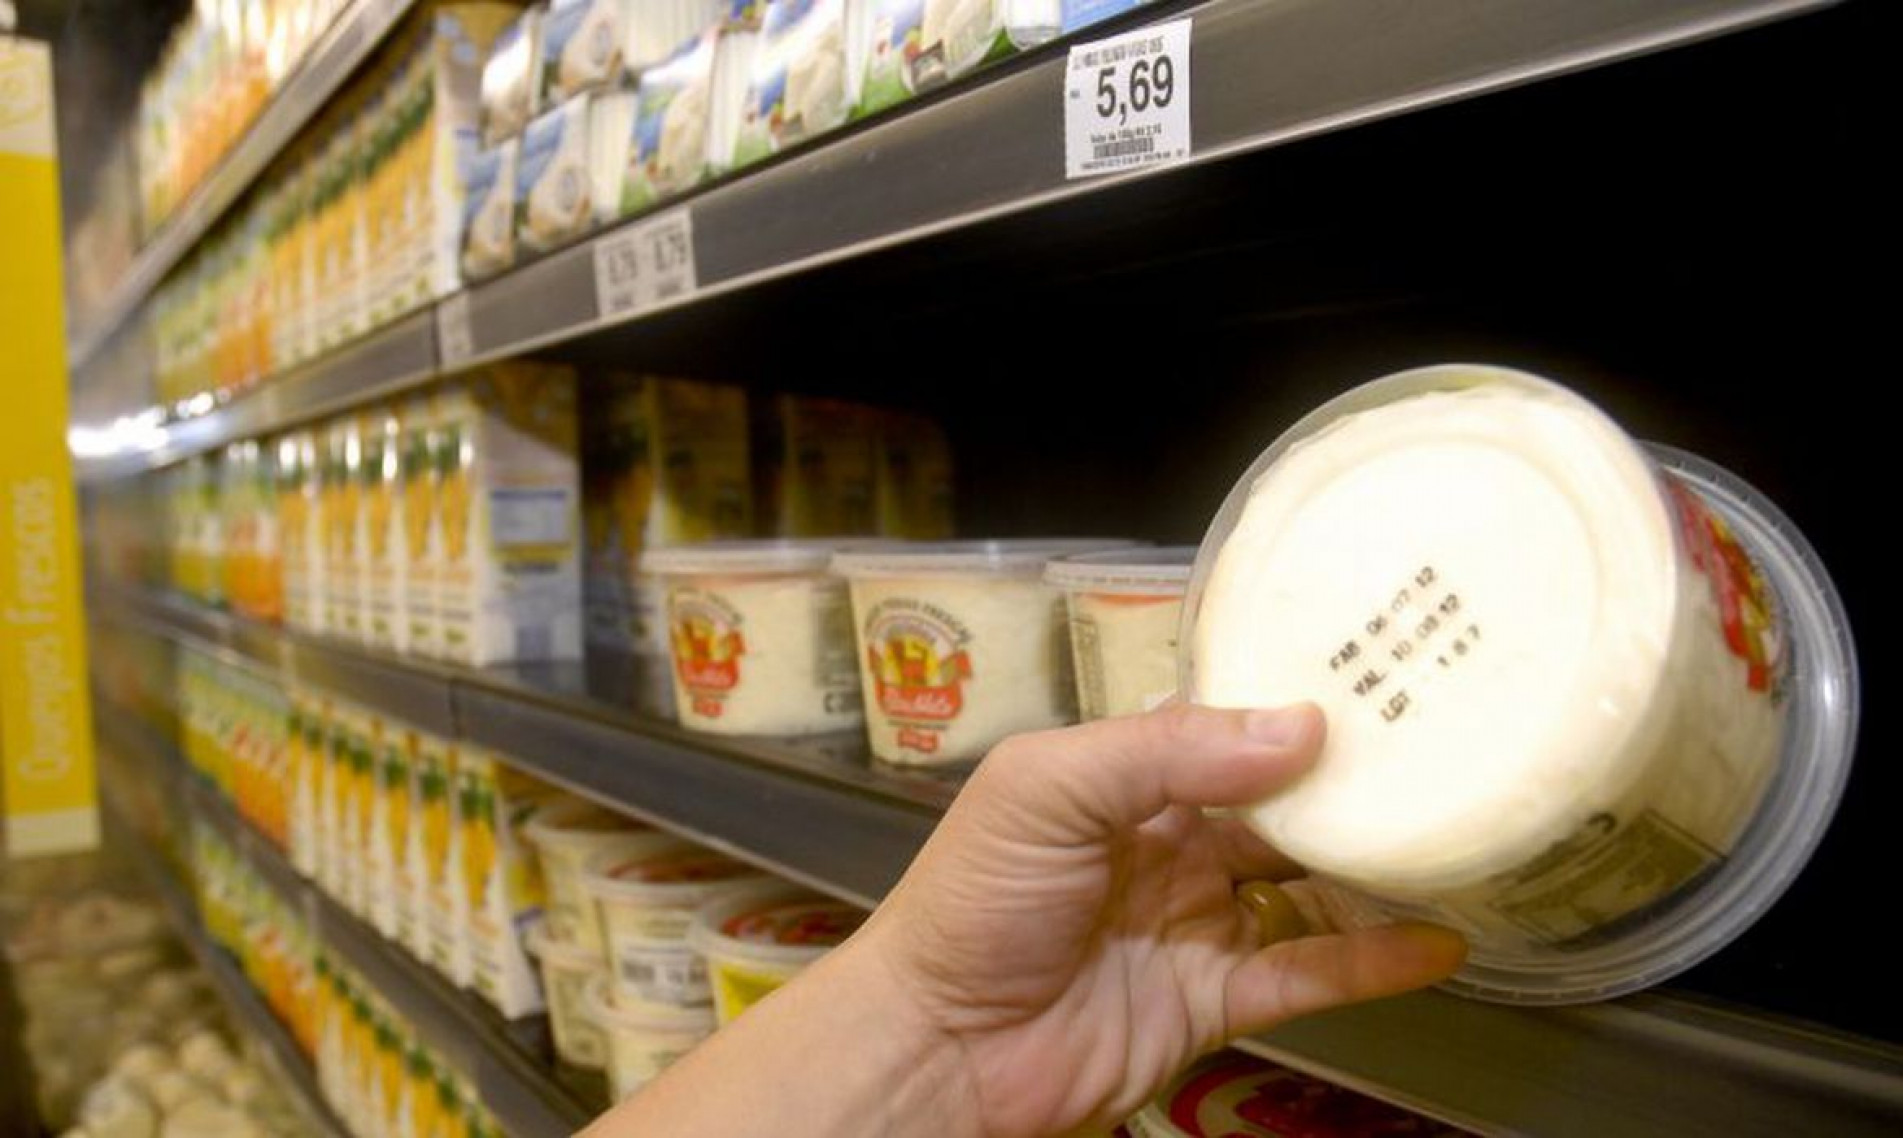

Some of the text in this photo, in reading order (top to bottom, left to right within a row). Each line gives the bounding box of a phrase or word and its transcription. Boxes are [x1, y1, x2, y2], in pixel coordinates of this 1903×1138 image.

[1096, 54, 1174, 126] 5,69
[1329, 638, 1362, 671] FAB
[1414, 565, 1435, 588] 12
[1391, 639, 1413, 662] 10
[1439, 592, 1460, 616] 12
